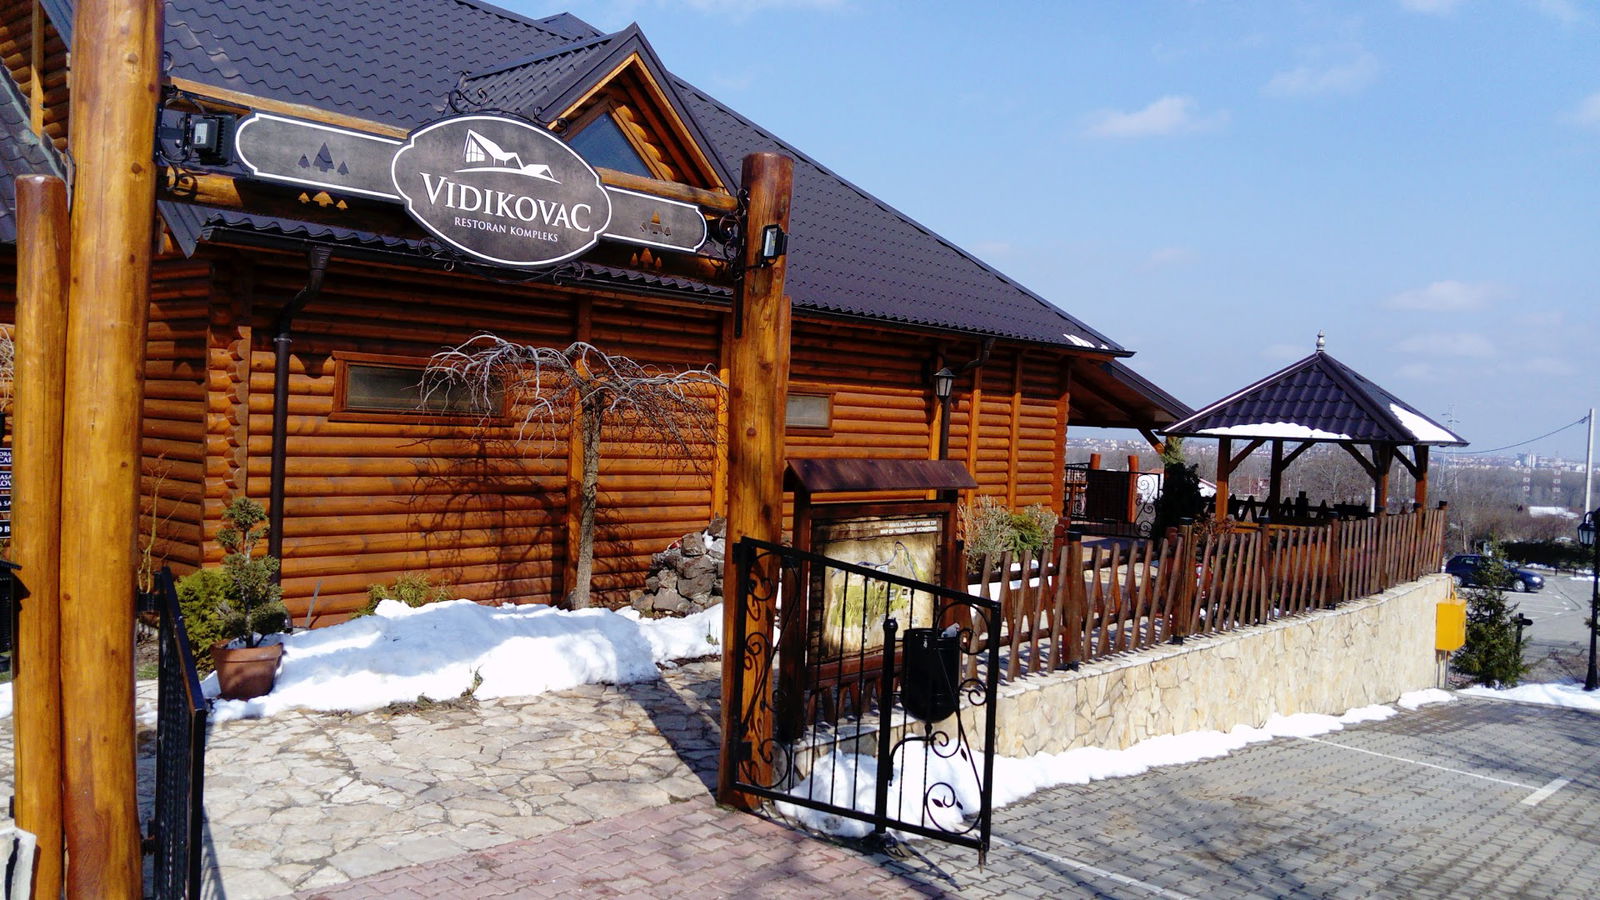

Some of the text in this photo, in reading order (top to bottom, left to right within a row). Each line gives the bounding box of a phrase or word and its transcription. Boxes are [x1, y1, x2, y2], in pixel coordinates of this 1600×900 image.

[419, 172, 592, 232] VIDIKOVAC
[454, 216, 558, 242] RESTORAN KOMPLEKS
